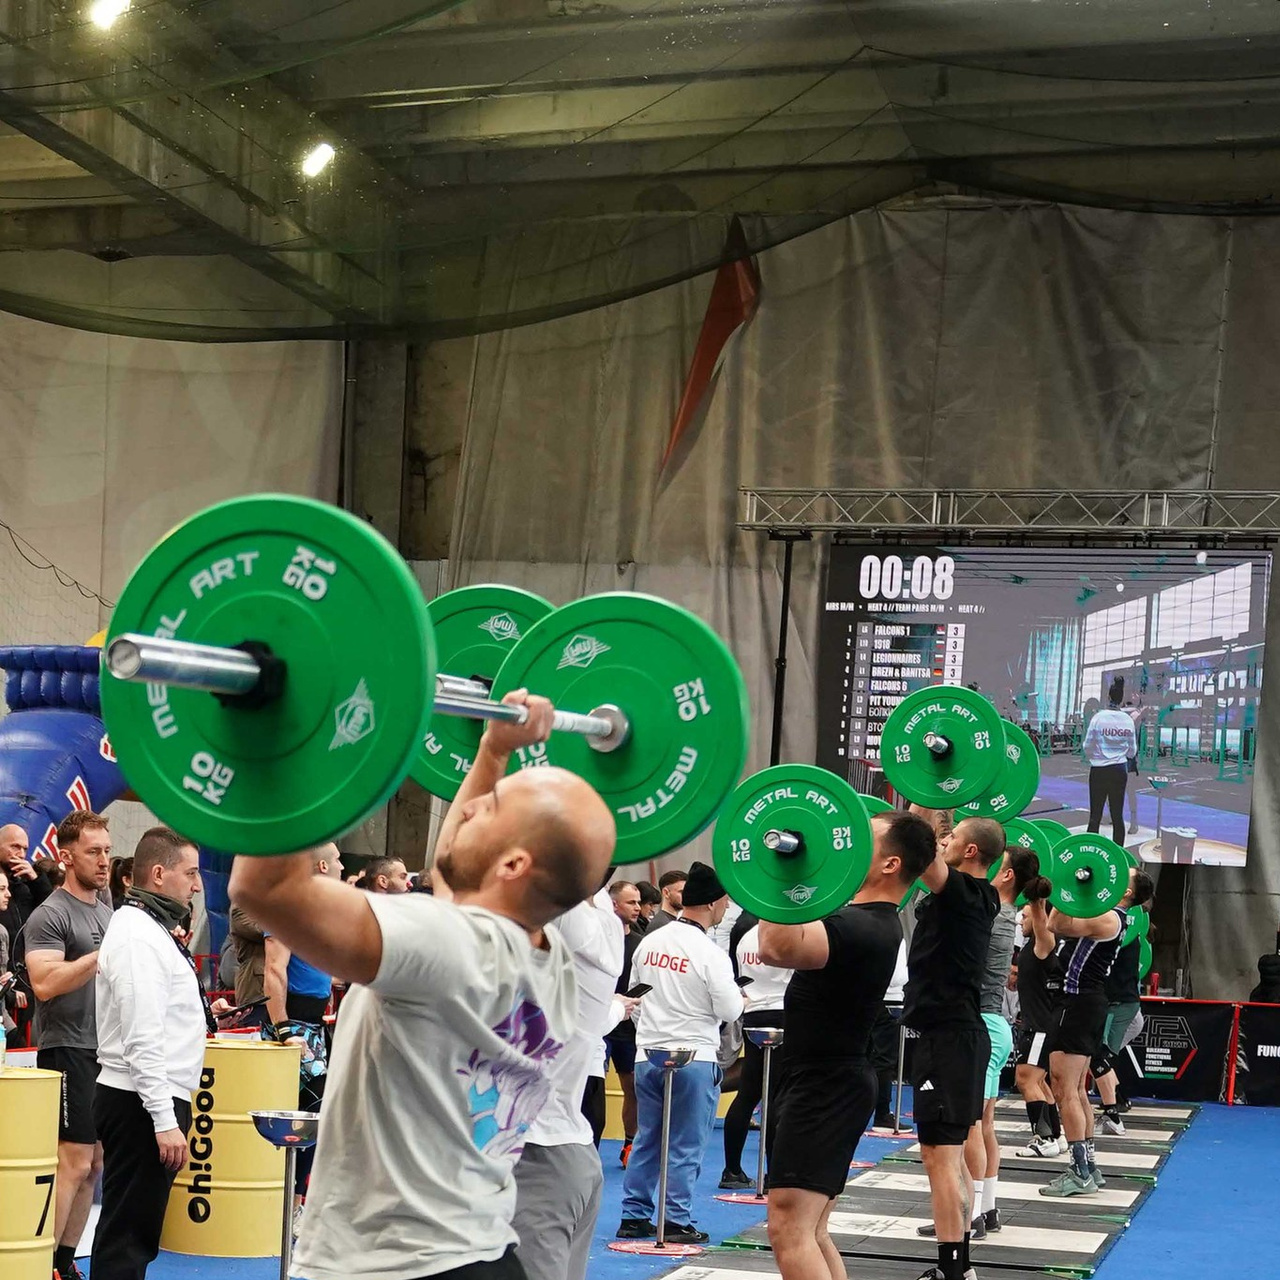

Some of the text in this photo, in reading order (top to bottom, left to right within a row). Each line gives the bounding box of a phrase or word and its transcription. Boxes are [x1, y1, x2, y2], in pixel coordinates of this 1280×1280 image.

[282, 545, 318, 591] KG
[302, 557, 337, 601] 10
[859, 555, 955, 600] 00:08
[867, 603, 883, 612] HEAT
[895, 604, 911, 612] TEAM
[911, 604, 929, 613] PAIRS
[958, 605, 974, 613] HEAT
[874, 625, 905, 636] FALCONS
[953, 627, 959, 636] 3
[146, 551, 260, 739] MEAL ART
[874, 639, 891, 650] 1918
[952, 641, 958, 649] 3
[872, 653, 921, 664] LEGIONNAIRES
[951, 654, 957, 663] 3
[900, 667, 931, 678] BANITSA
[950, 668, 956, 677] 3
[673, 677, 704, 704] KG
[870, 681, 901, 691] FALCONS
[869, 696, 882, 706] PIT
[678, 700, 711, 722] 10
[904, 703, 978, 734] METAL ART
[974, 730, 989, 741] KG
[895, 744, 910, 754] 10
[975, 740, 991, 750] 10
[866, 749, 876, 759] PR
[896, 754, 911, 763] KG
[182, 751, 216, 794] 10
[201, 763, 235, 806] KG
[617, 745, 698, 822] METAL
[744, 787, 838, 824] METAL ART
[832, 826, 851, 838] KG
[730, 838, 750, 851] 10
[833, 838, 853, 850] 10
[733, 851, 751, 862] KG
[1080, 845, 1110, 862] METAL
[643, 951, 690, 974] JUDGE
[34, 1174, 55, 1237] 7
